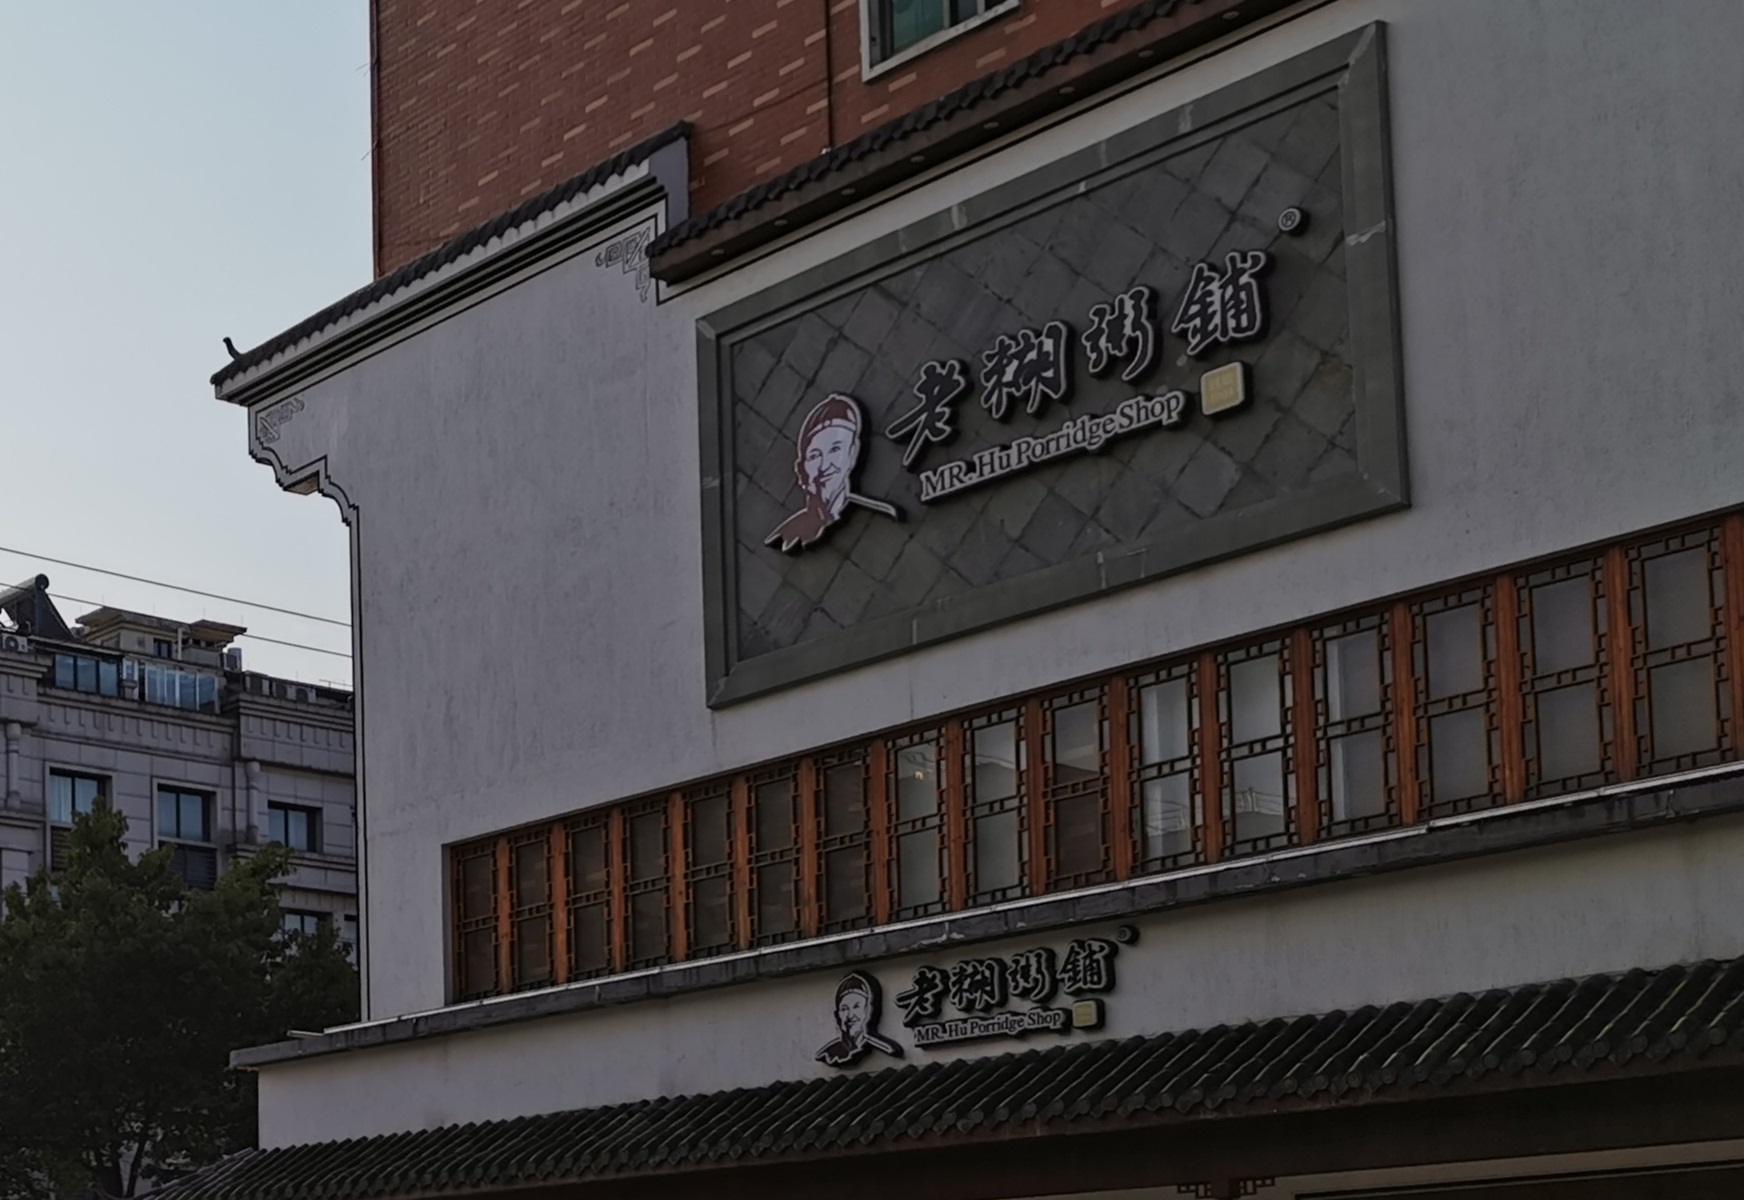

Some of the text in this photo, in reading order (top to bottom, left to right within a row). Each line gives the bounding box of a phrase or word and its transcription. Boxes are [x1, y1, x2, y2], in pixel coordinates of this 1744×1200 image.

[920, 389, 1184, 500] MR. Hu Porridge Shop
[947, 1022, 968, 1038] Hu
[969, 1013, 1026, 1034] Porridge
[1027, 1009, 1063, 1028] Shop
